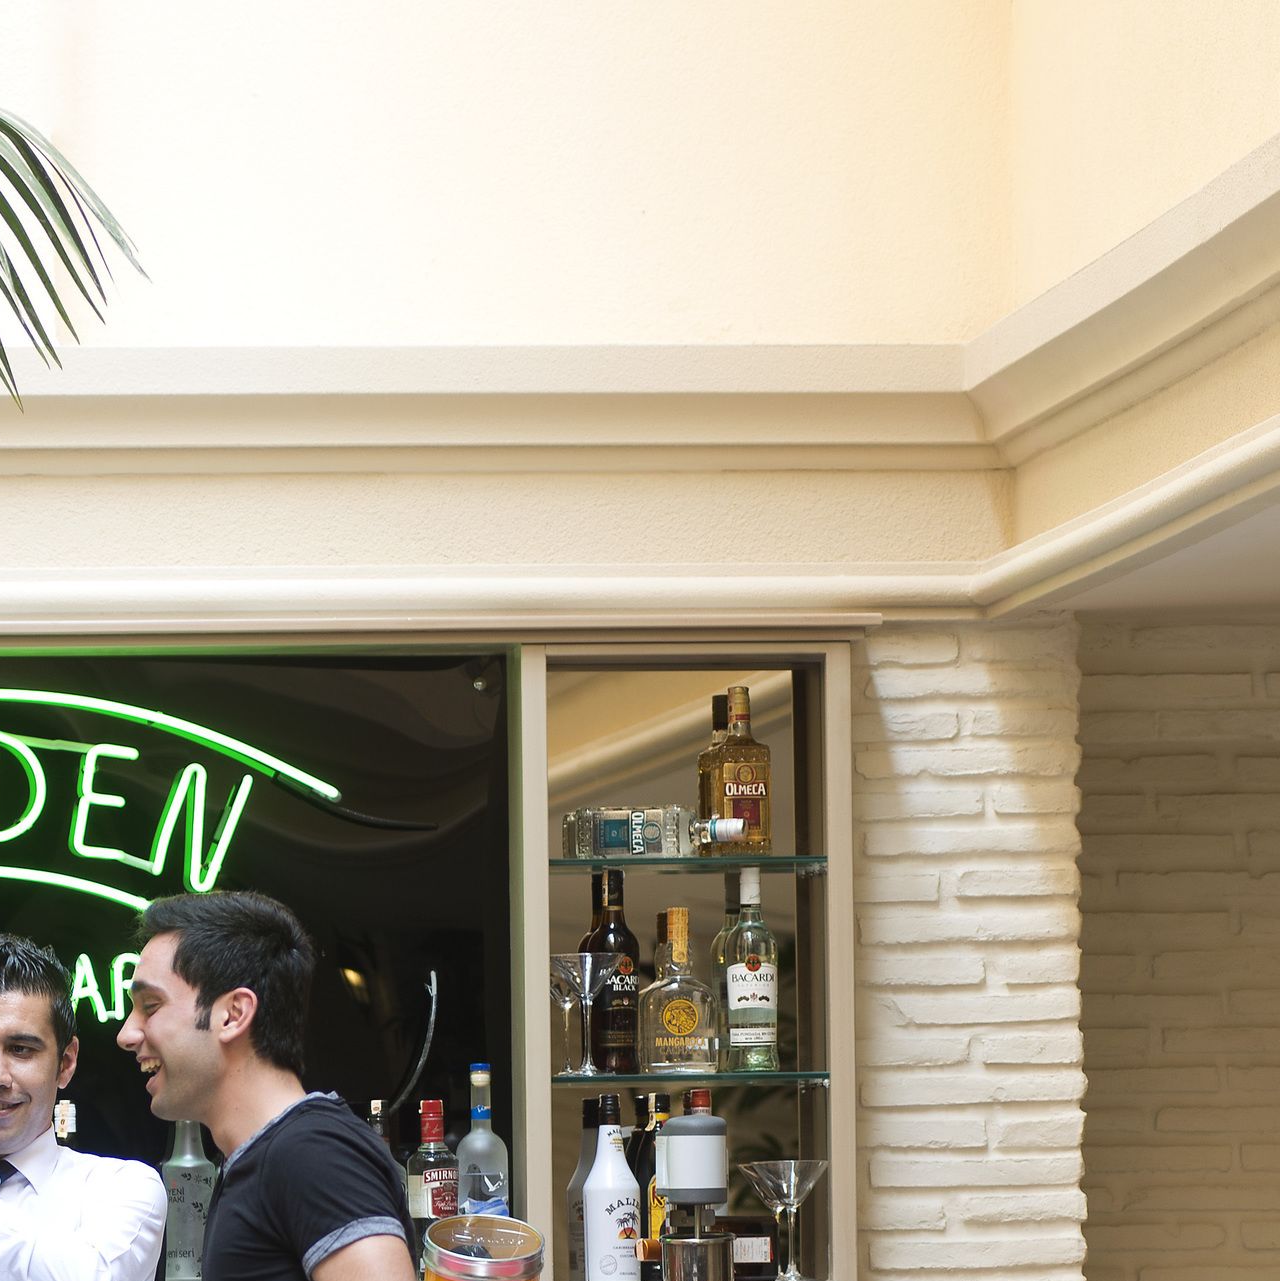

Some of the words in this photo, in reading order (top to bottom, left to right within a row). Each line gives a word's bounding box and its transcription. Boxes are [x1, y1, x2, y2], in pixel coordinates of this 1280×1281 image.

[725, 783, 766, 796] OLMECA
[631, 811, 644, 854] OLMECA
[67, 952, 142, 1024] AR
[731, 973, 774, 983] BACARDI
